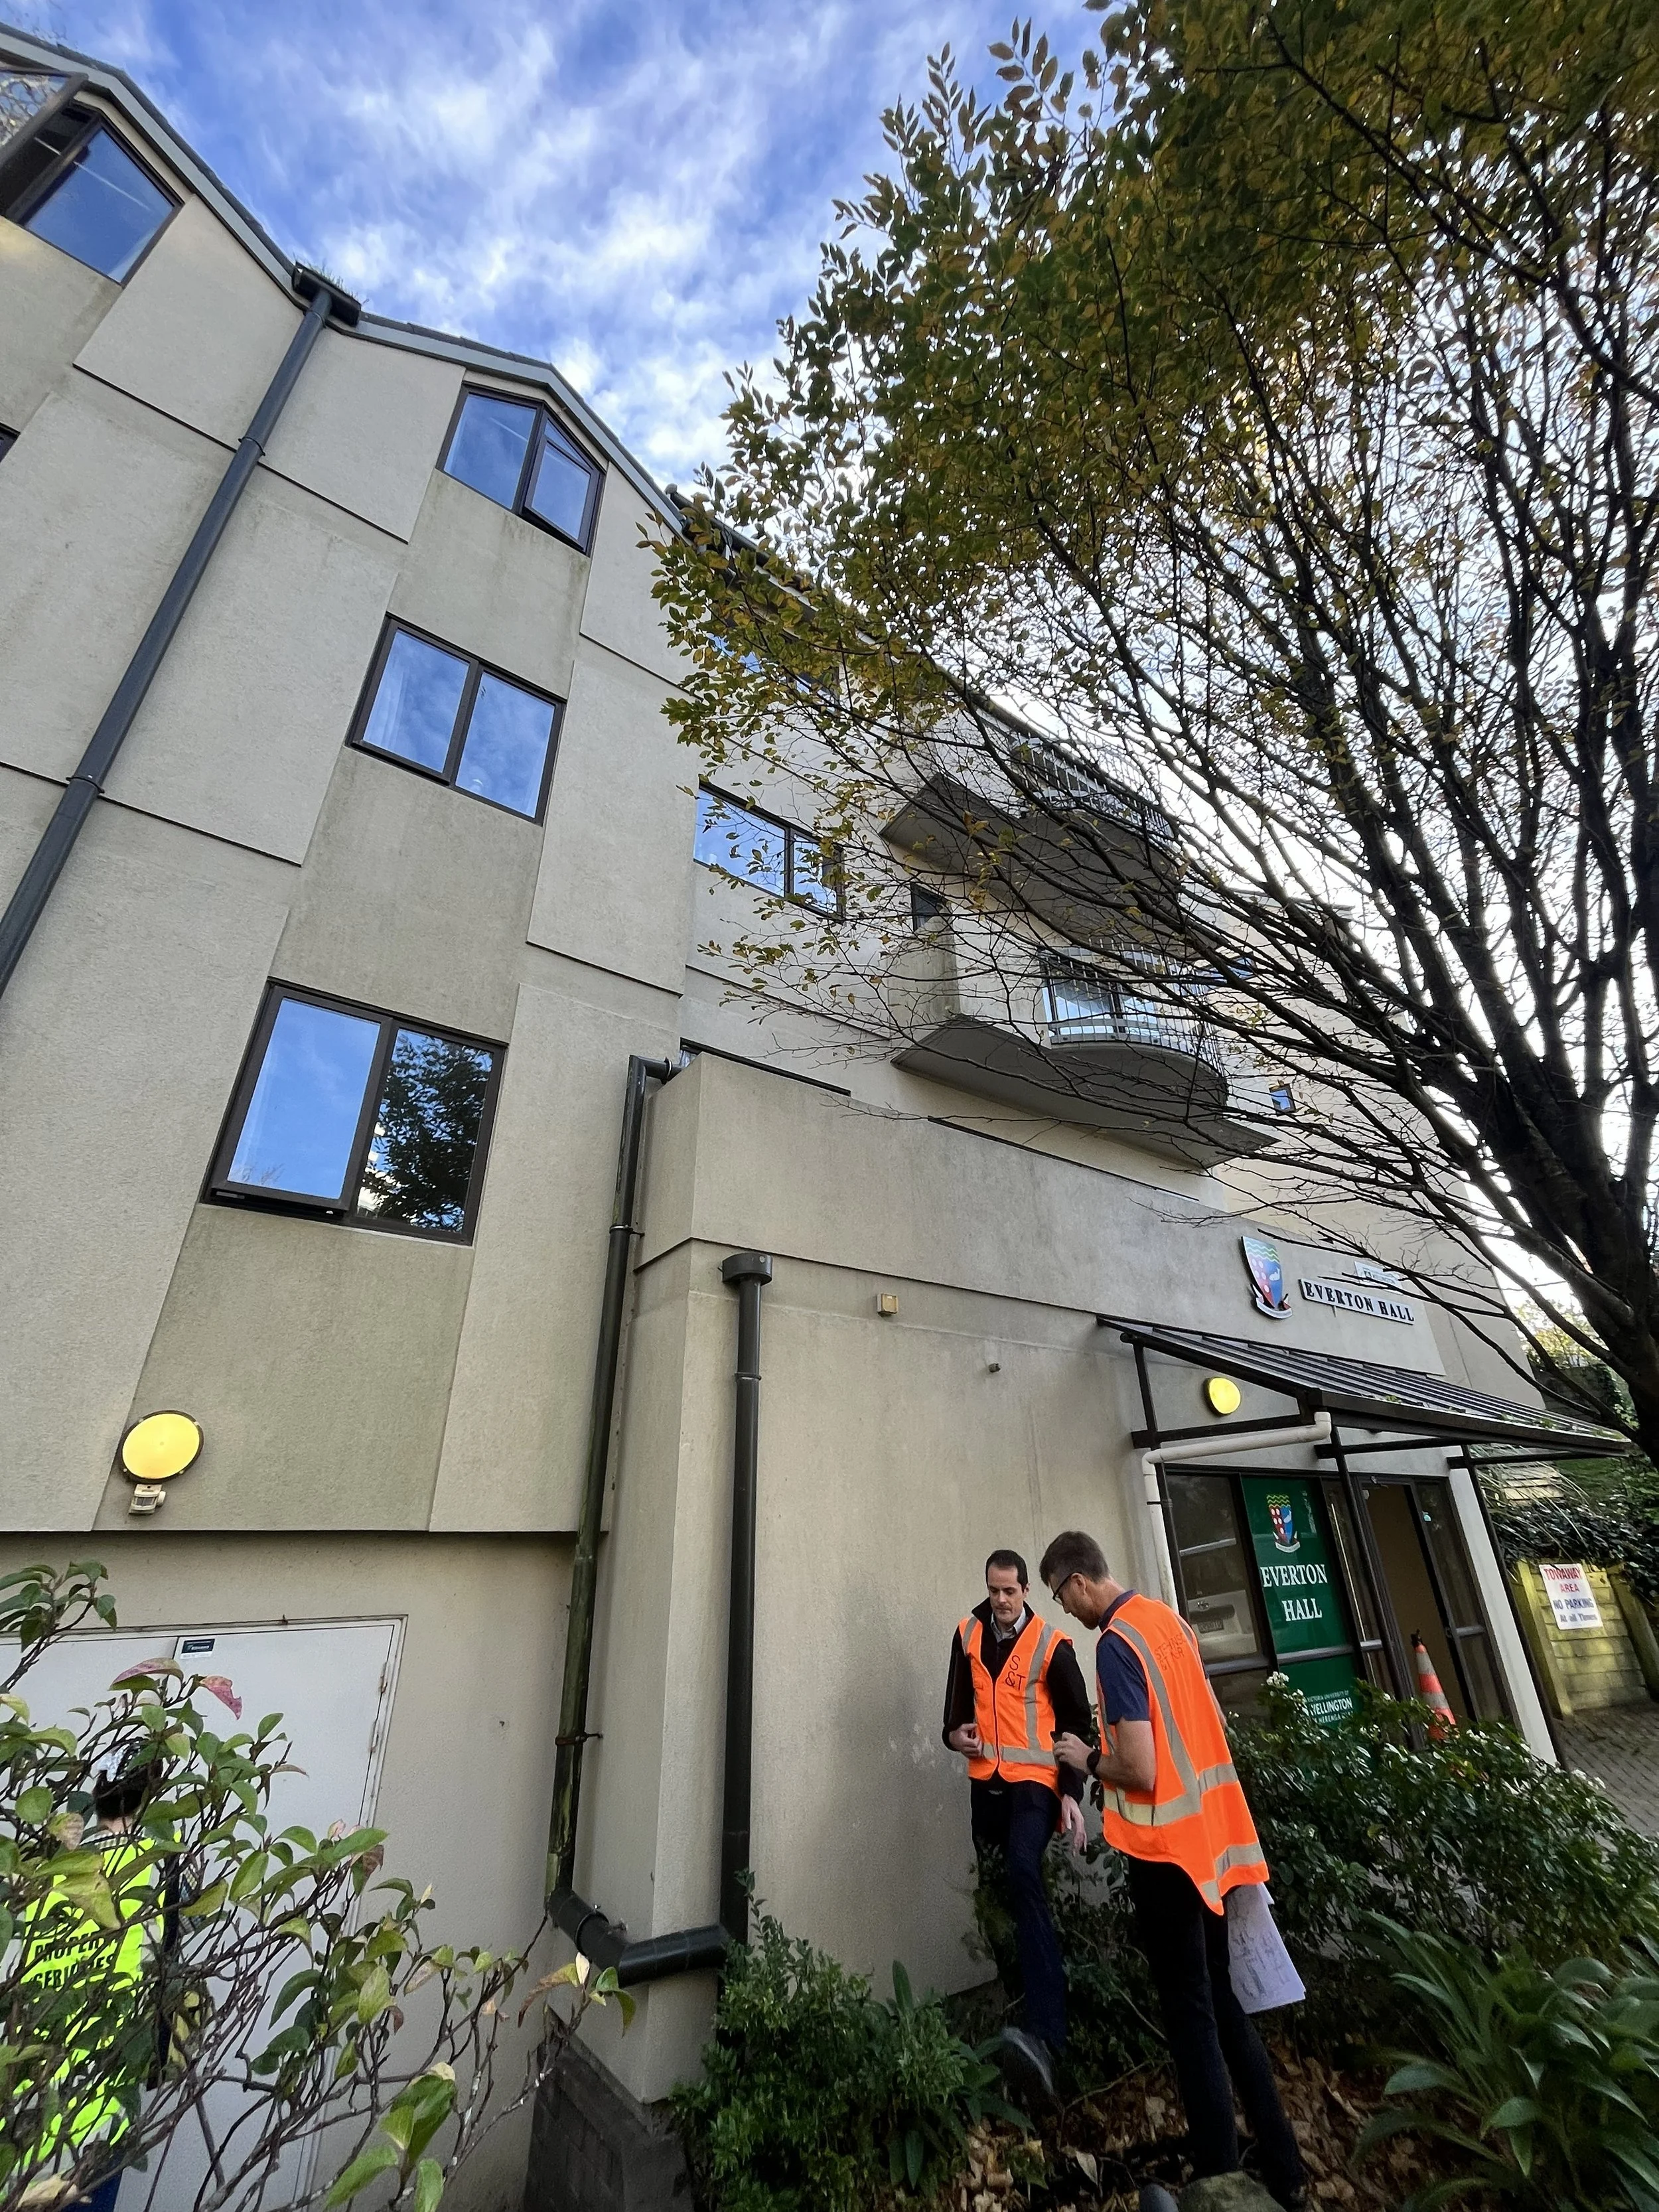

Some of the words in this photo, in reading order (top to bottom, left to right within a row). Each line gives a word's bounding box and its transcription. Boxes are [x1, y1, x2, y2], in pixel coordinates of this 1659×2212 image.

[1303, 1281, 1374, 1312] EVERTON
[1378, 1300, 1414, 1321] HALL
[1260, 1564, 1327, 1587] EVERTON
[1560, 1583, 1580, 1593] AREA
[1281, 1598, 1322, 1621] HALL
[1553, 1599, 1563, 1610] NO
[1564, 1598, 1595, 1609] PARKING
[1009, 1655, 1021, 1670] S
[1005, 1671, 1026, 1690] &T
